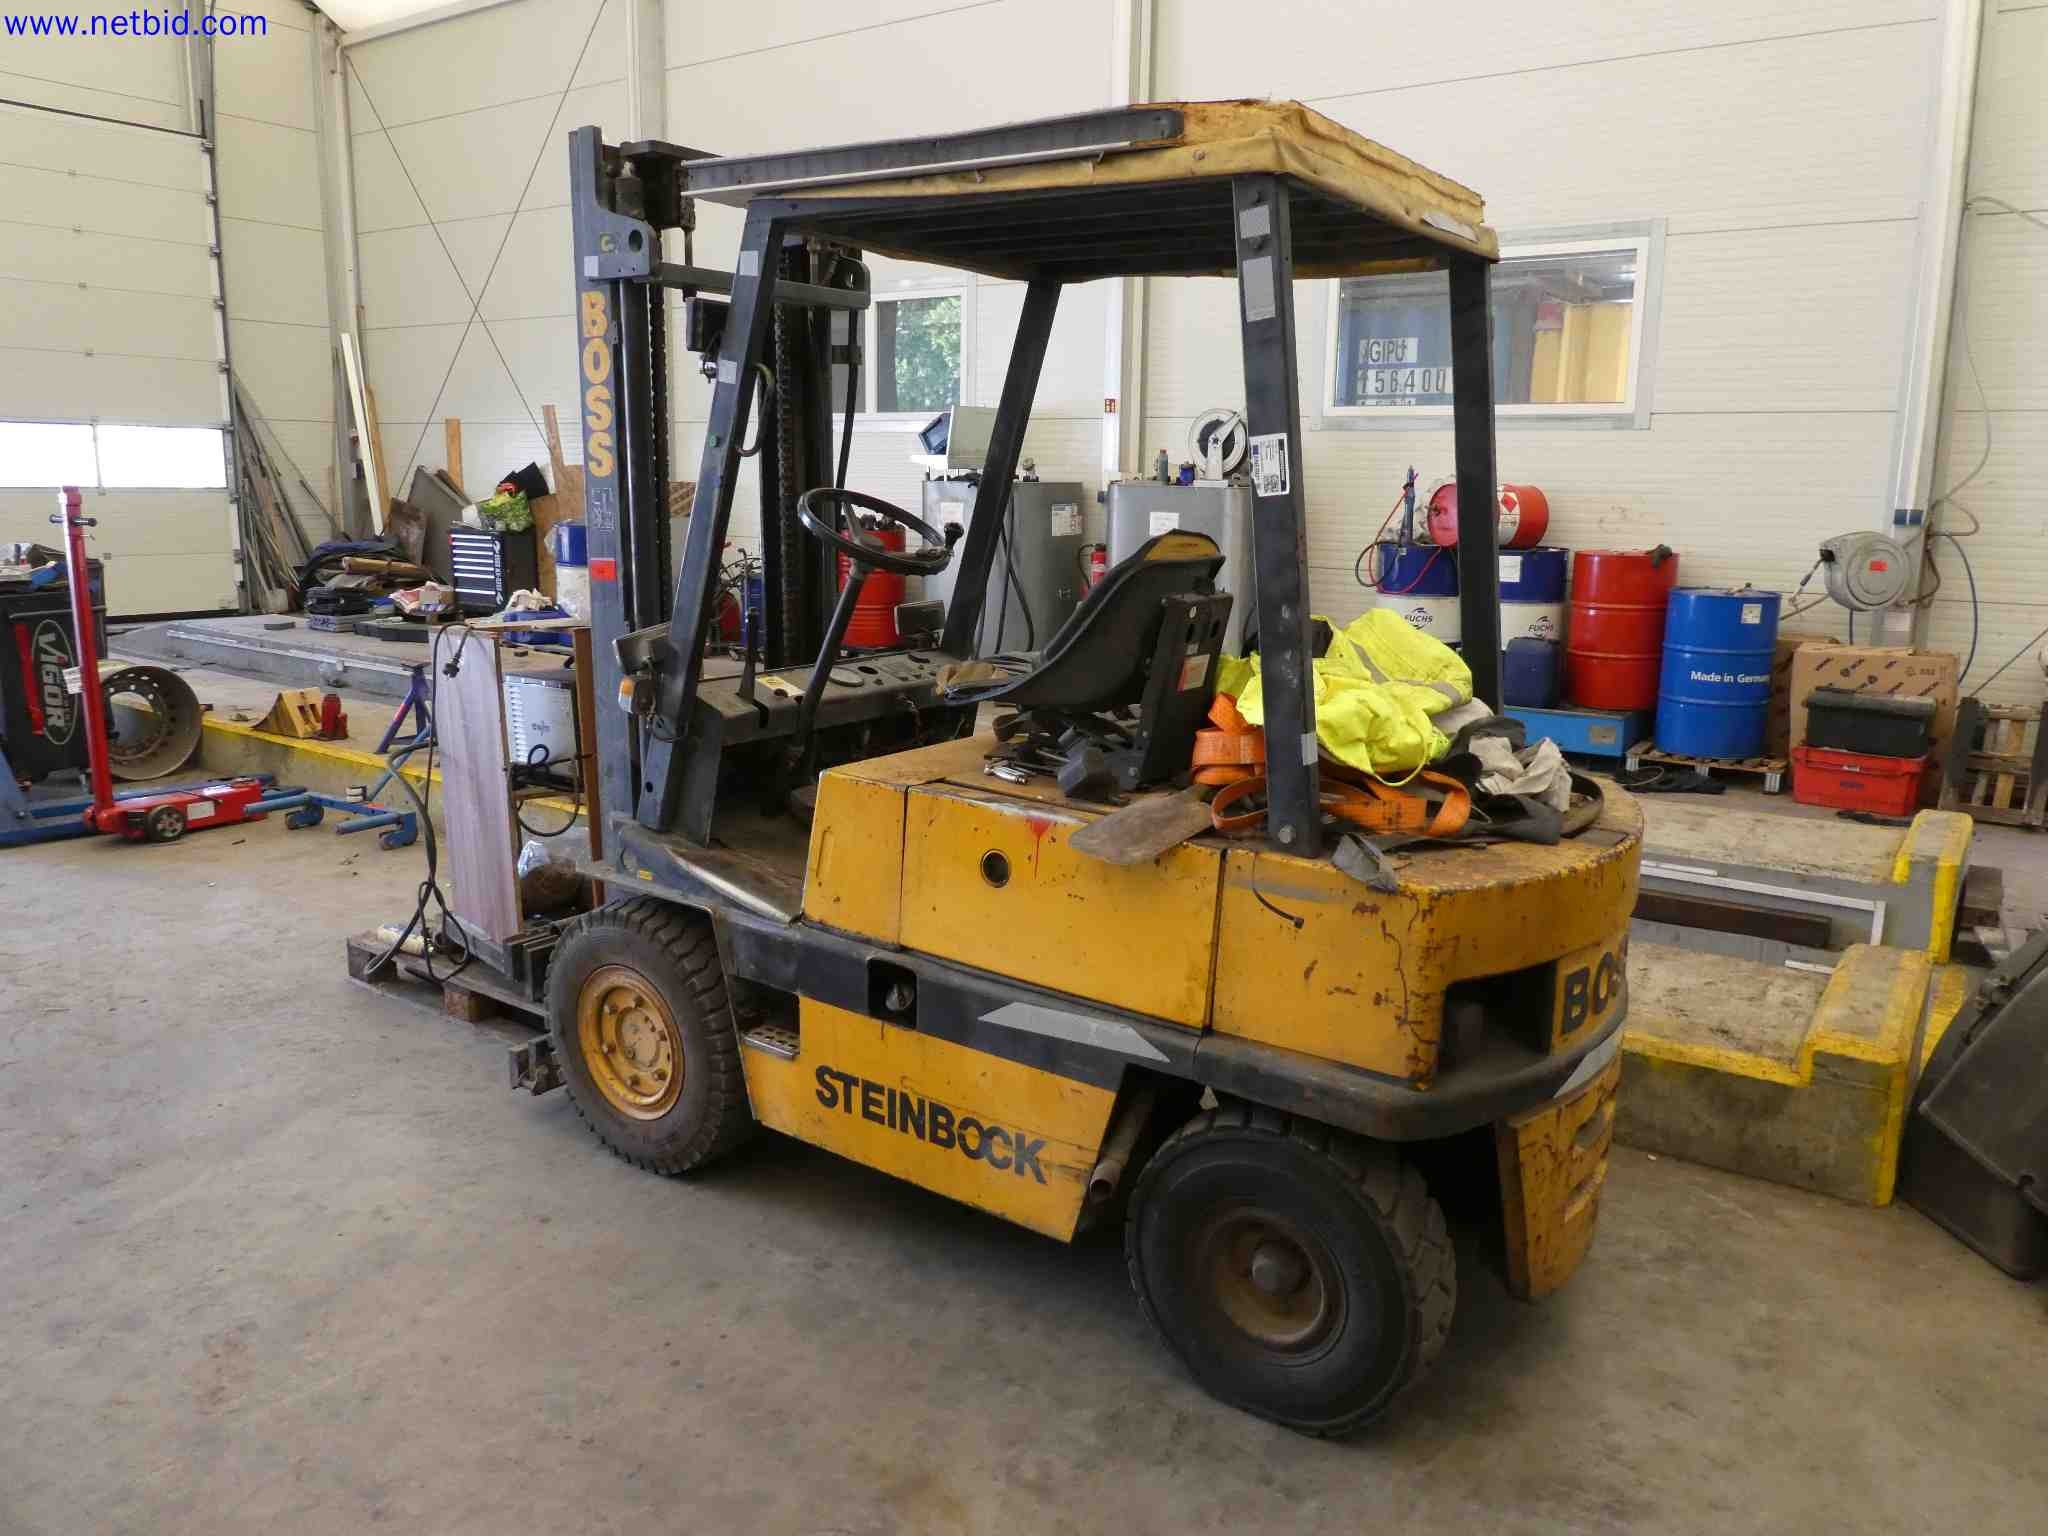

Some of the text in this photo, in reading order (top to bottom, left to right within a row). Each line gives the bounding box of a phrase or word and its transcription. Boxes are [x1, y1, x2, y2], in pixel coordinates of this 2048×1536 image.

[581, 290, 614, 478] BOSS
[1690, 671, 1721, 682] Made
[1724, 673, 1734, 682] in
[815, 1064, 1049, 1186] STEINBOCK
